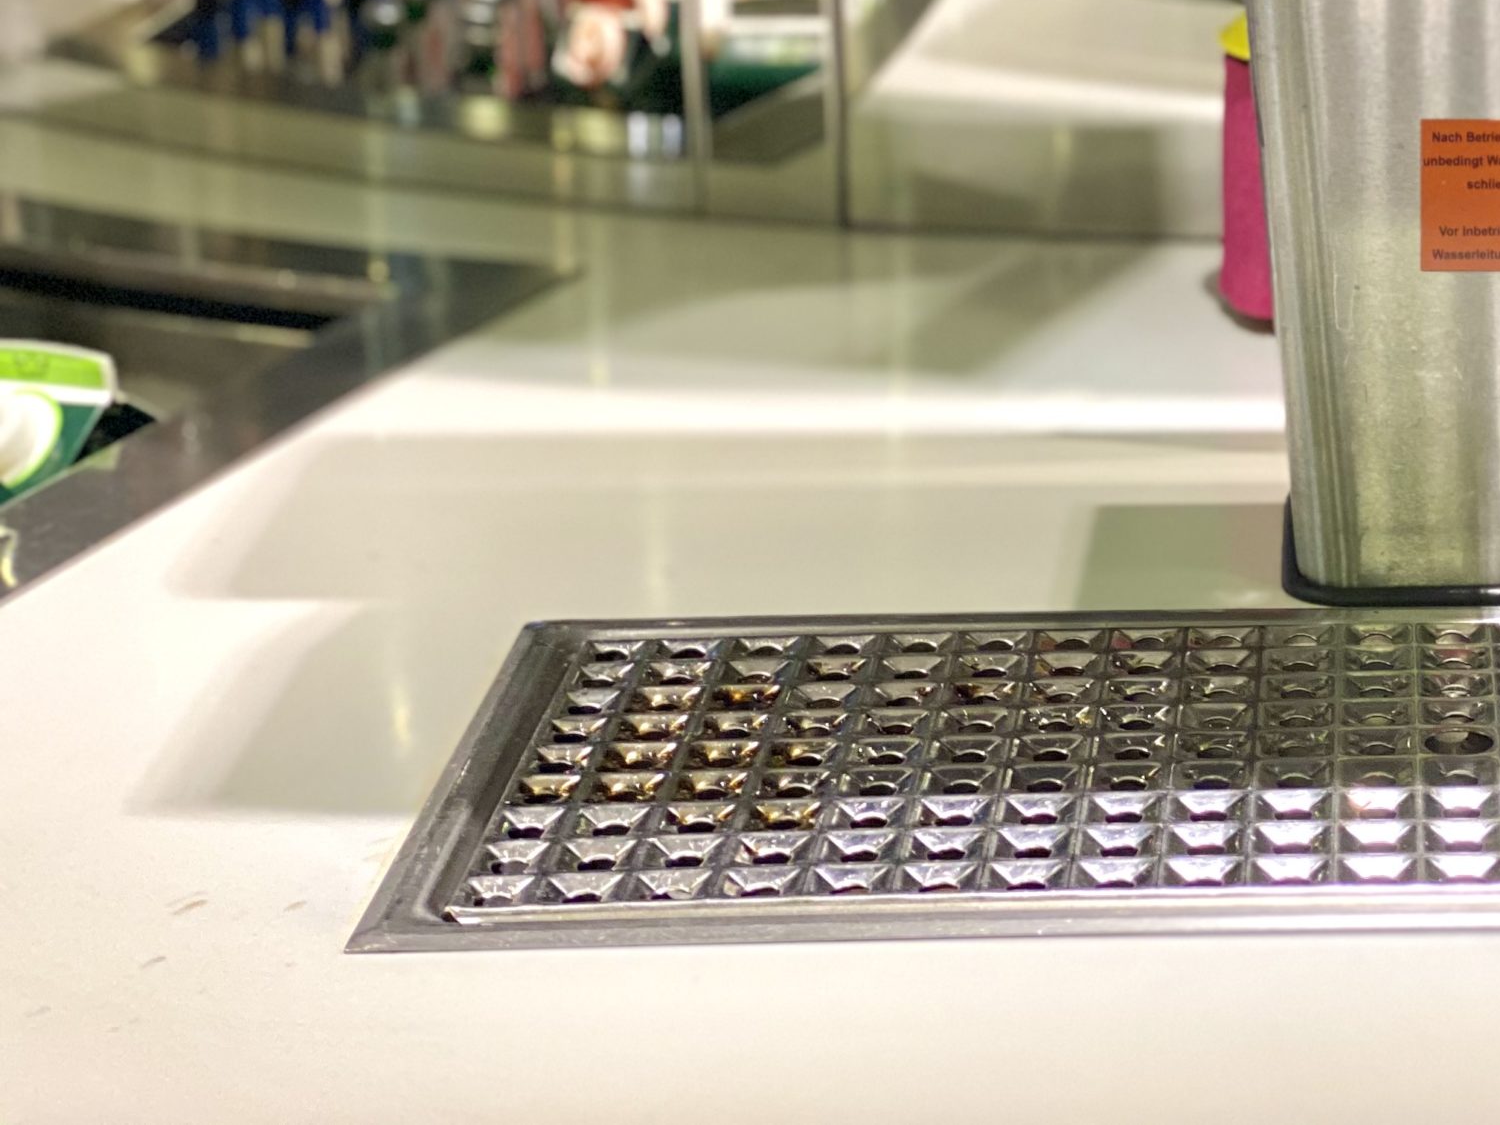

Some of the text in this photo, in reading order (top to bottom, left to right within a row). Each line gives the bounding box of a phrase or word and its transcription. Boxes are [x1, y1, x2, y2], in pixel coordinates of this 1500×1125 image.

[1432, 131, 1462, 143] Nach
[1422, 156, 1483, 168] unbedingt
[1439, 226, 1458, 236] Vor
